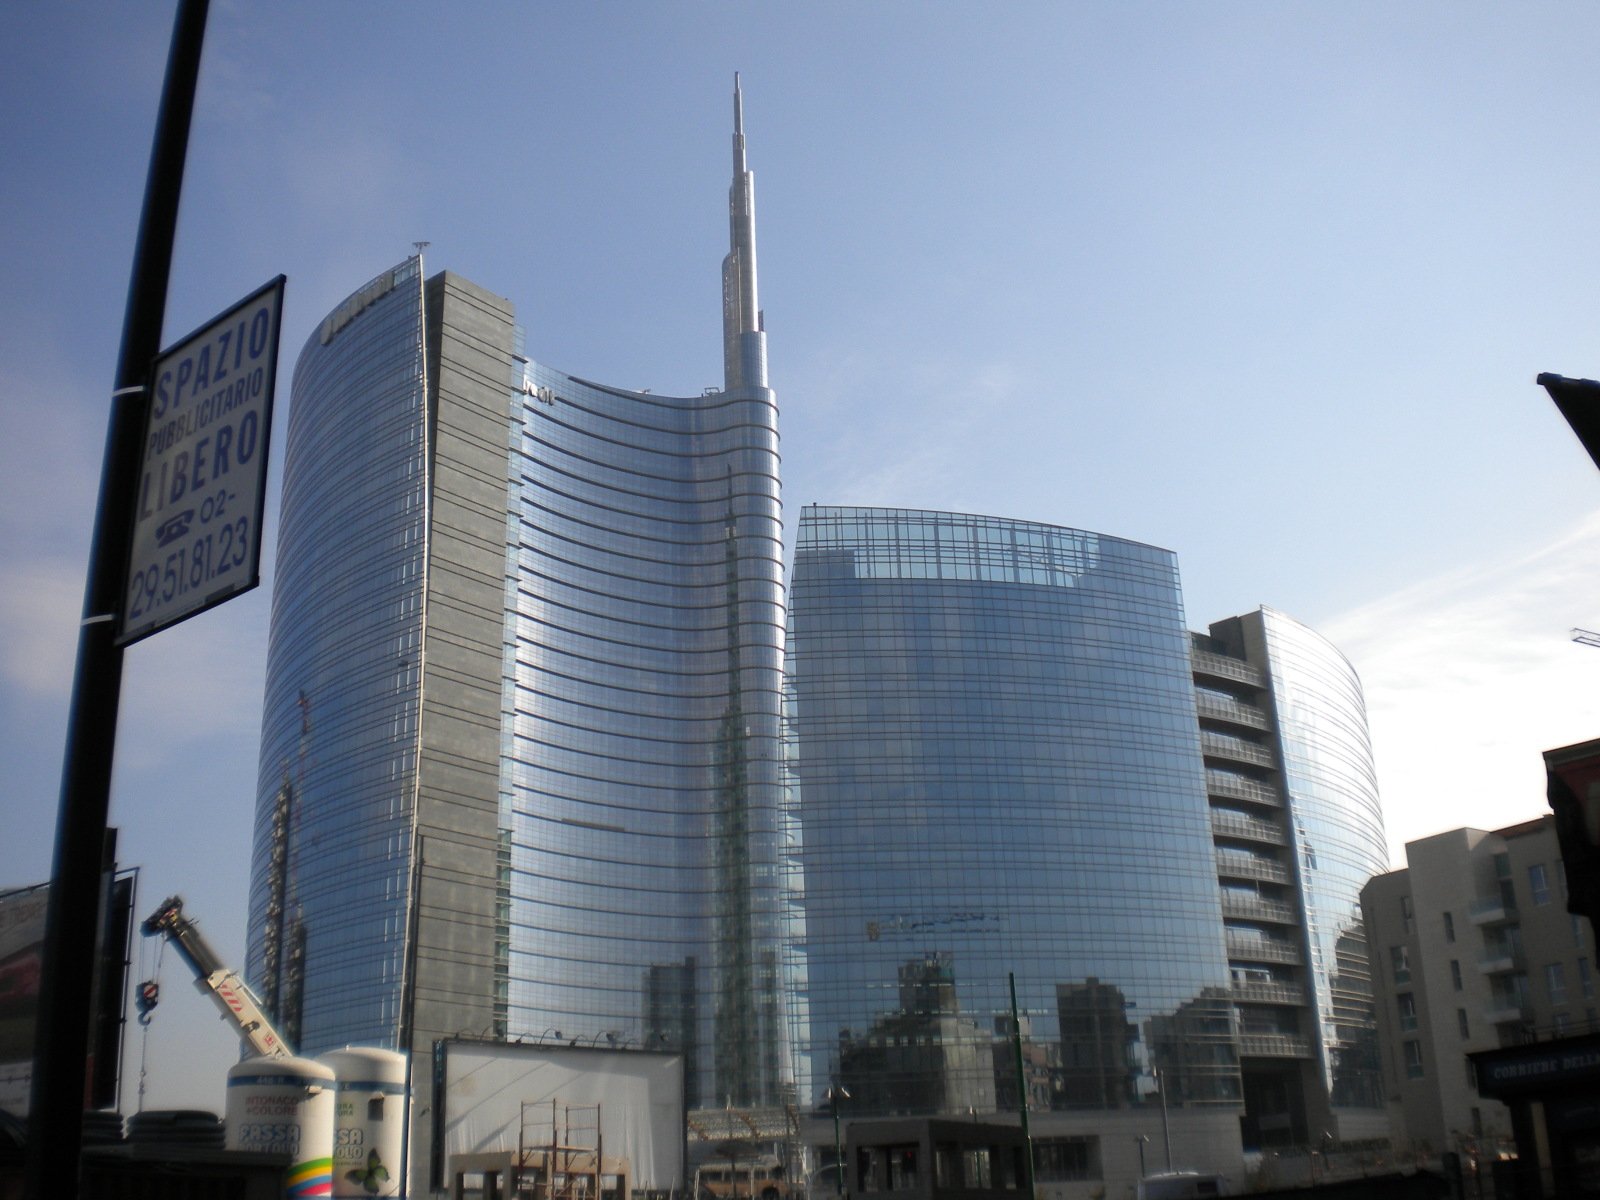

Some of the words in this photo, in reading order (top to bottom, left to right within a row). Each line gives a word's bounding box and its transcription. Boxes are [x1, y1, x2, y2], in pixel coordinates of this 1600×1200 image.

[147, 365, 264, 461] PUBBLICITARIO
[153, 306, 270, 421] SPAZIO
[138, 409, 258, 523] LIBERO
[129, 515, 249, 620] 29.51.81.23
[1493, 1059, 1558, 1079] CORRIERE
[239, 1124, 301, 1142] FASSA
